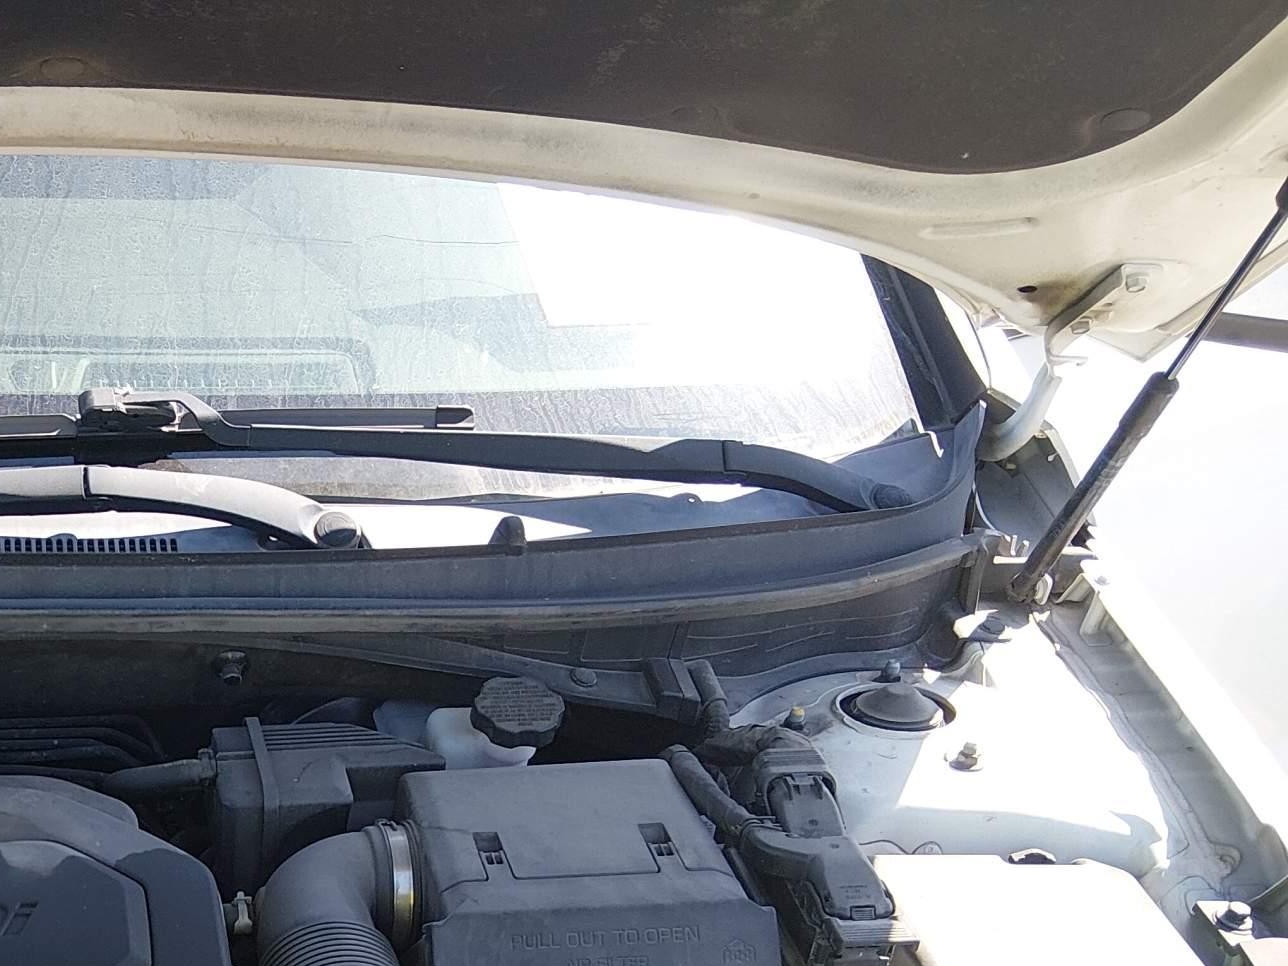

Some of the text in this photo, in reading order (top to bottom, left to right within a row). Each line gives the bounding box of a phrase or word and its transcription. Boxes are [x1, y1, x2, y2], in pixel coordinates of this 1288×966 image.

[511, 924, 701, 951] PULL OUT TO OPEN
